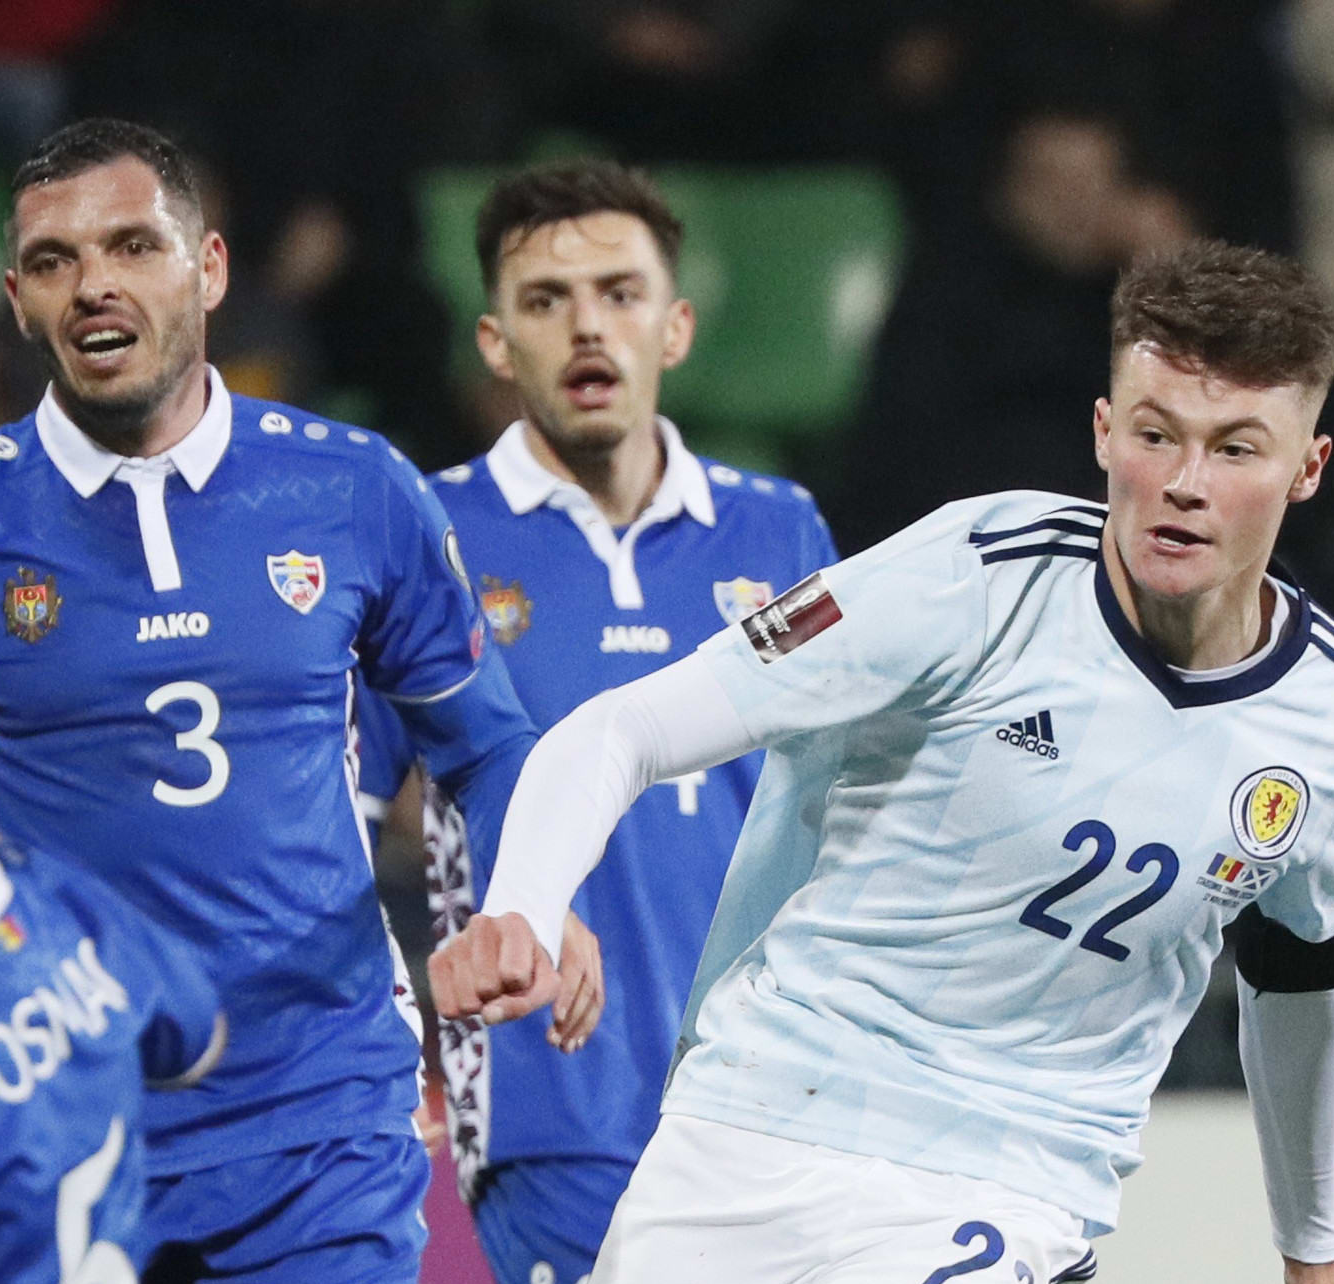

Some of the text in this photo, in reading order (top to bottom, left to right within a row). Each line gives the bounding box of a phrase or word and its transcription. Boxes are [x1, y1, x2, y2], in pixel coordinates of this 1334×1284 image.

[136, 611, 210, 643] JAKO
[145, 681, 230, 807] 3
[996, 728, 1060, 760] adidas
[1019, 819, 1180, 962] 22
